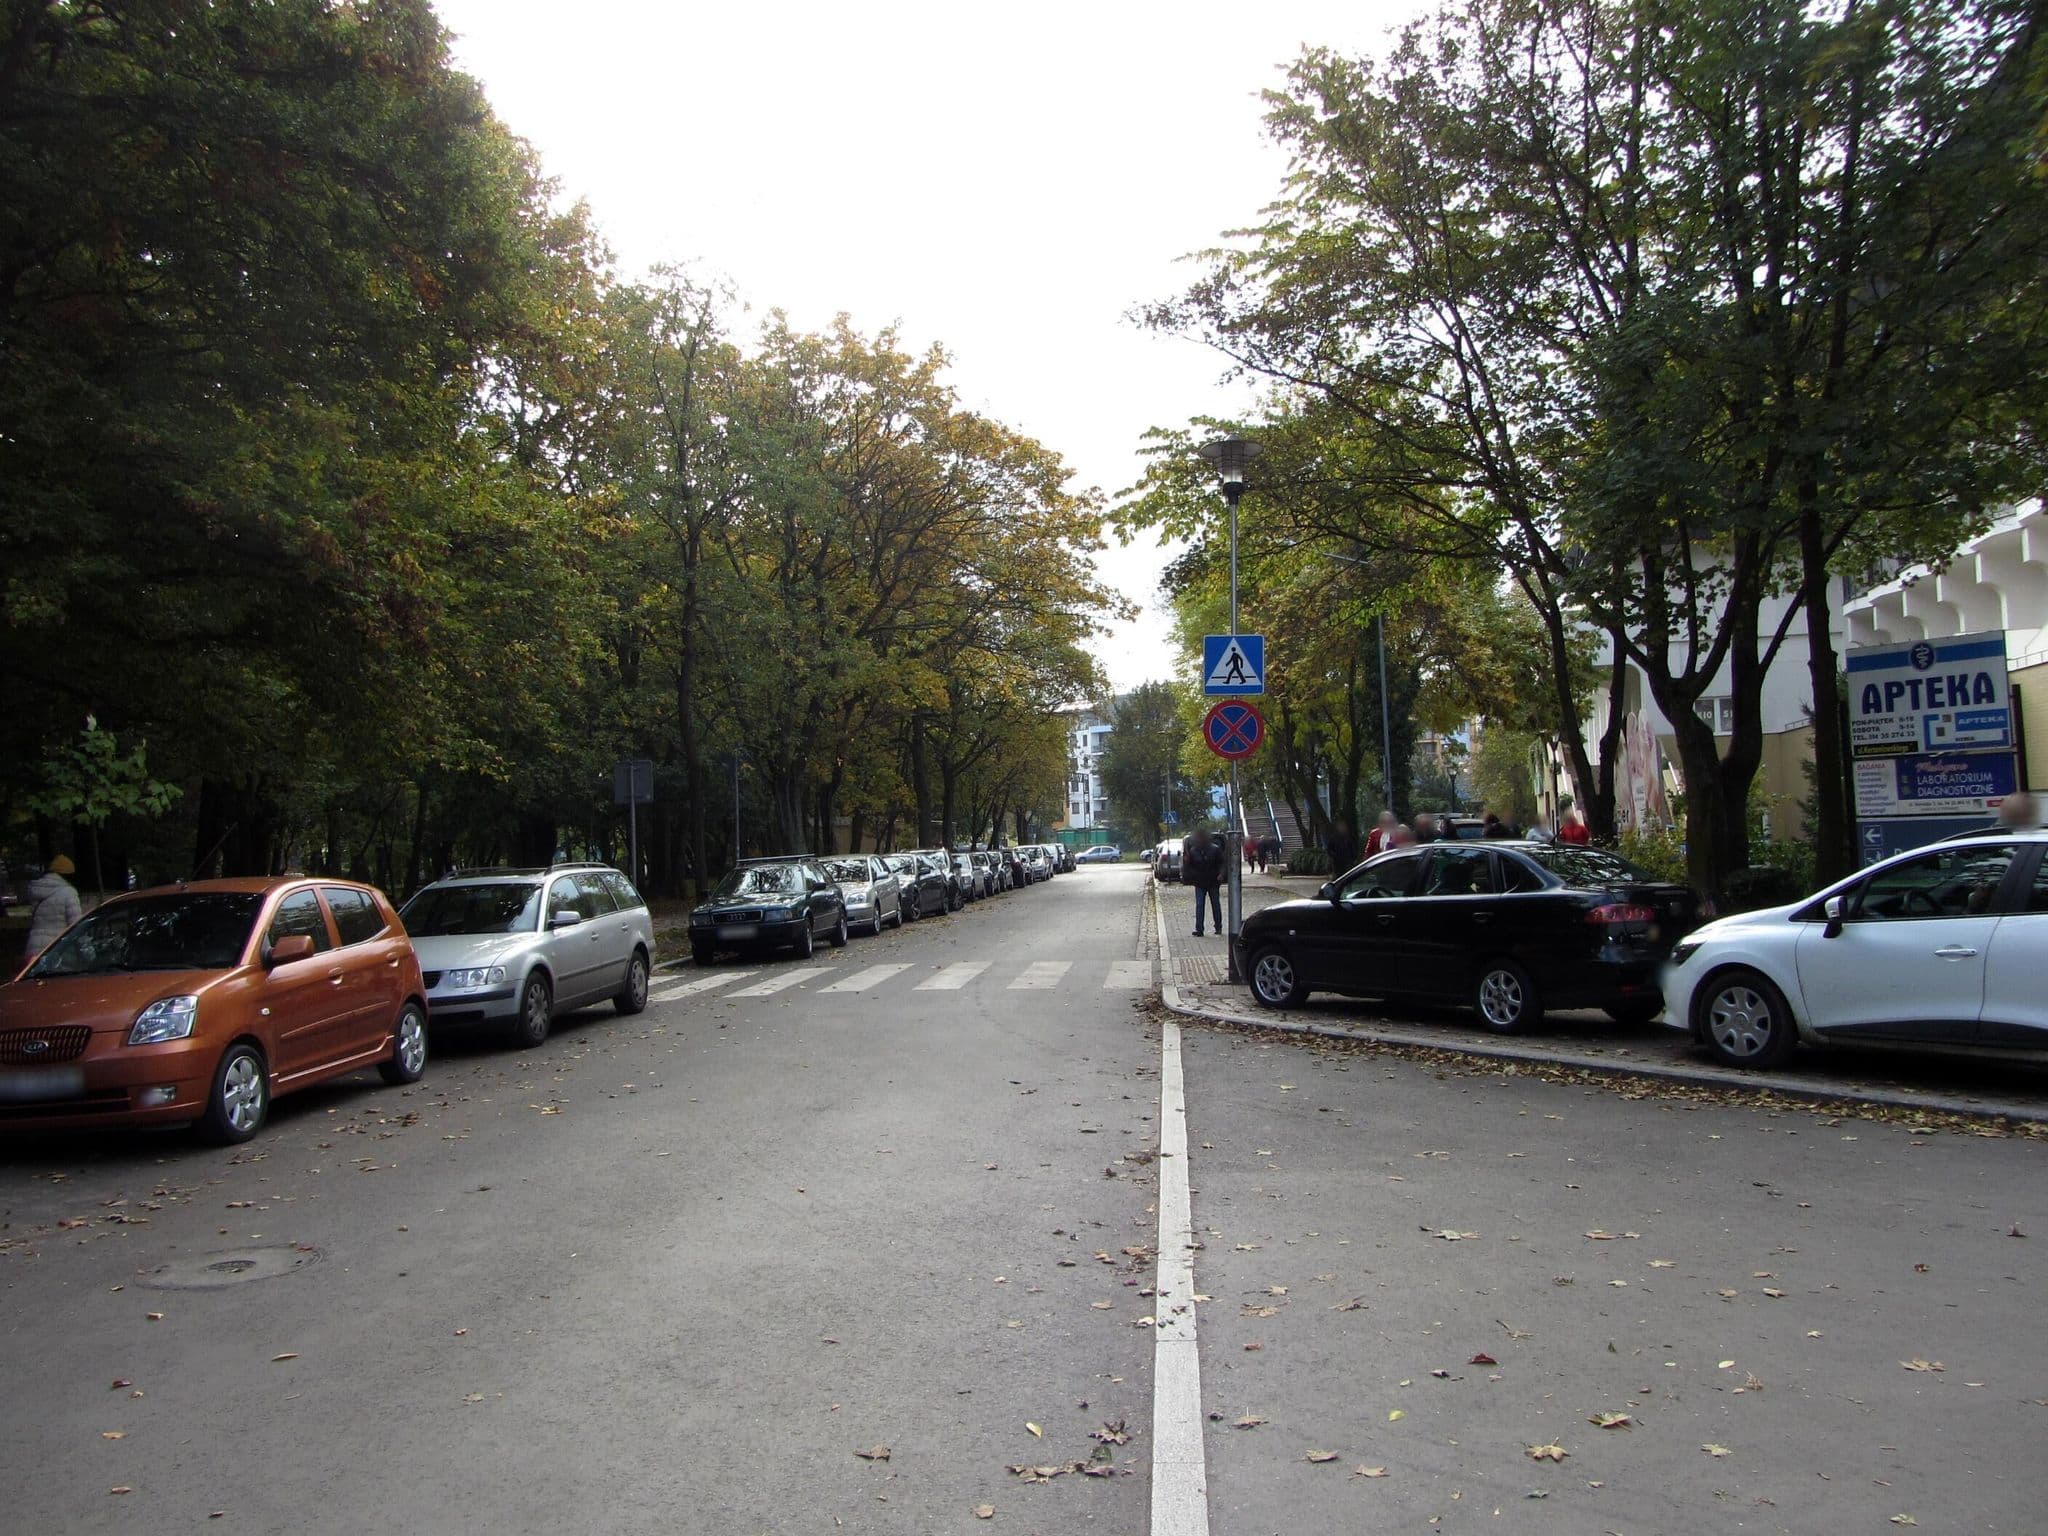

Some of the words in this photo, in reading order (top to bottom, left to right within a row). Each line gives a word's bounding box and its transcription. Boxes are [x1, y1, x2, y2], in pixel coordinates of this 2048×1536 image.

[1862, 672, 1994, 714] APTEKA
[1958, 715, 2005, 724] APTEKA
[1917, 772, 1993, 785] LABORATORIUM
[1918, 784, 1995, 797] DIAGNOSTYCZNE
